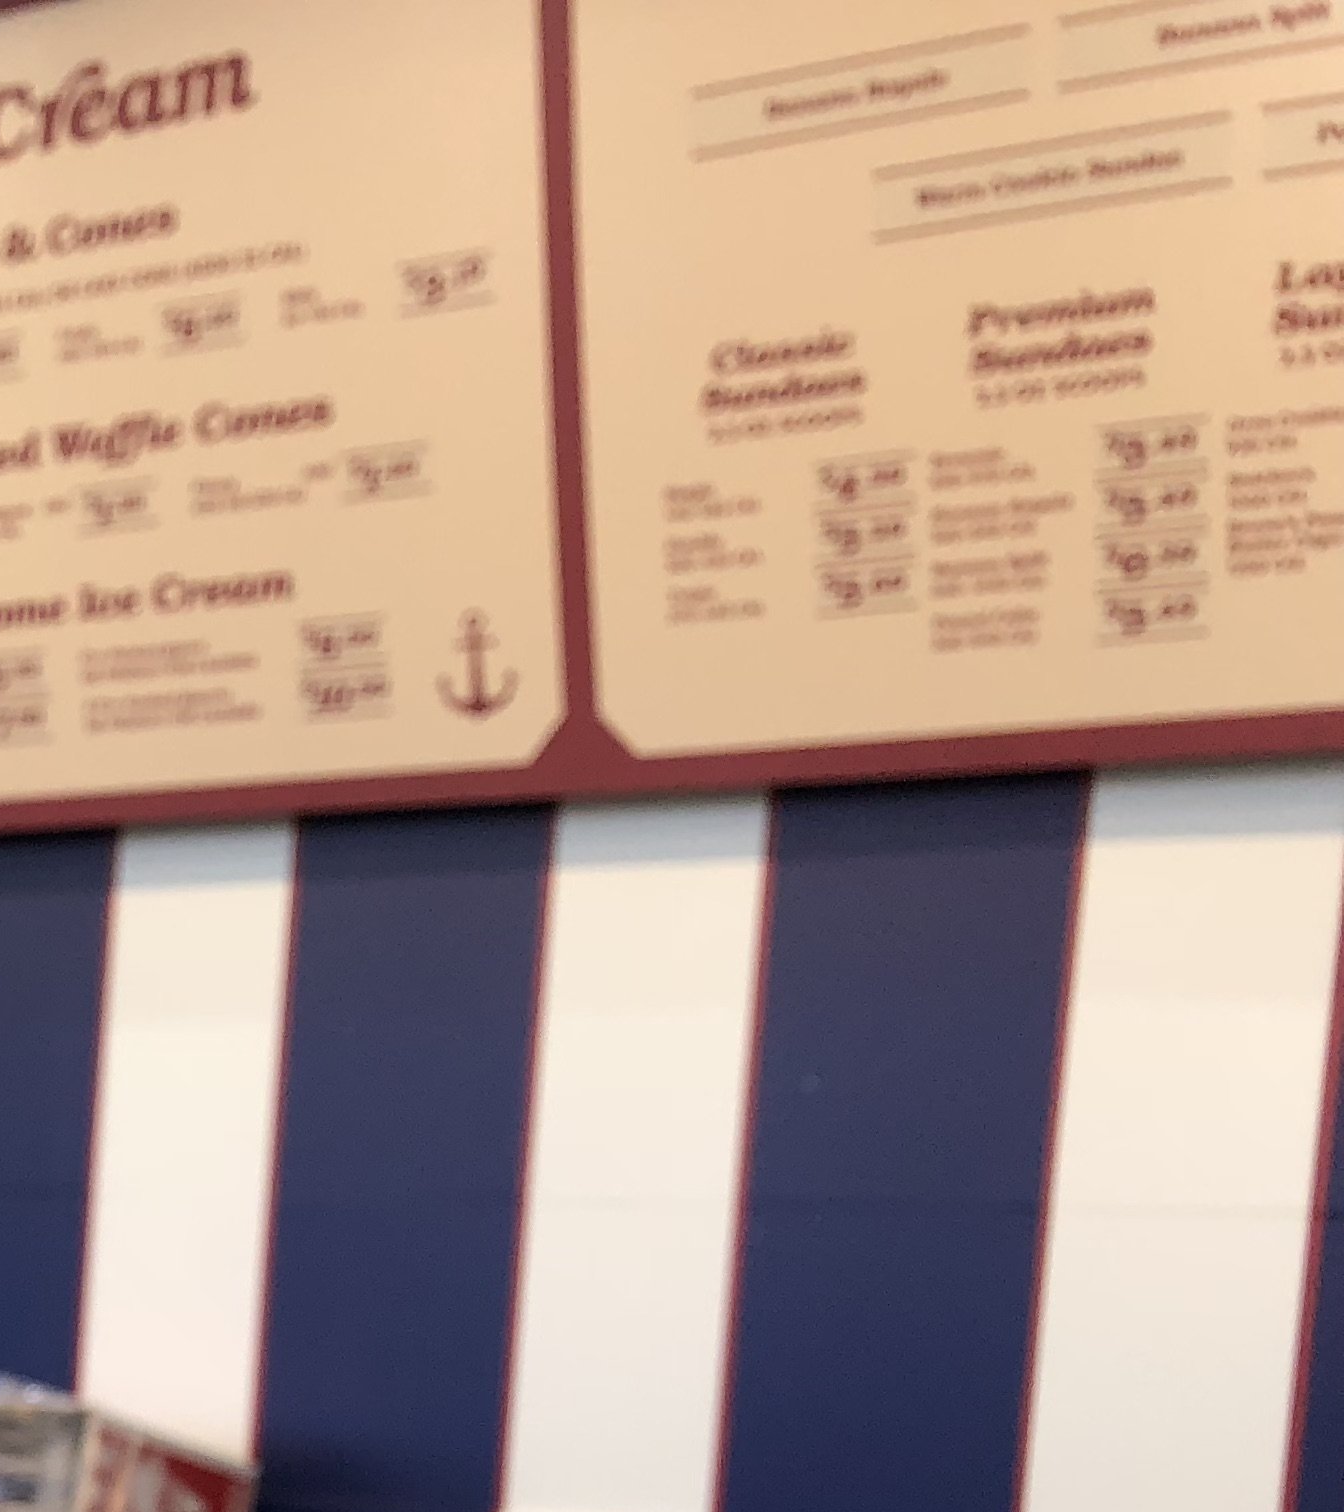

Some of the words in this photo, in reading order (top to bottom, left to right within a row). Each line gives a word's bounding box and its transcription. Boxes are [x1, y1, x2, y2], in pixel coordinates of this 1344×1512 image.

[3, 224, 37, 264] &
[46, 204, 180, 255] Cones
[967, 288, 1156, 337] Premium
[709, 327, 855, 375] Classic
[969, 329, 1155, 374] Sundaes
[50, 411, 182, 466] Waffle
[192, 395, 336, 443] Cones
[78, 580, 143, 620] Ice
[152, 569, 295, 616] Cream
